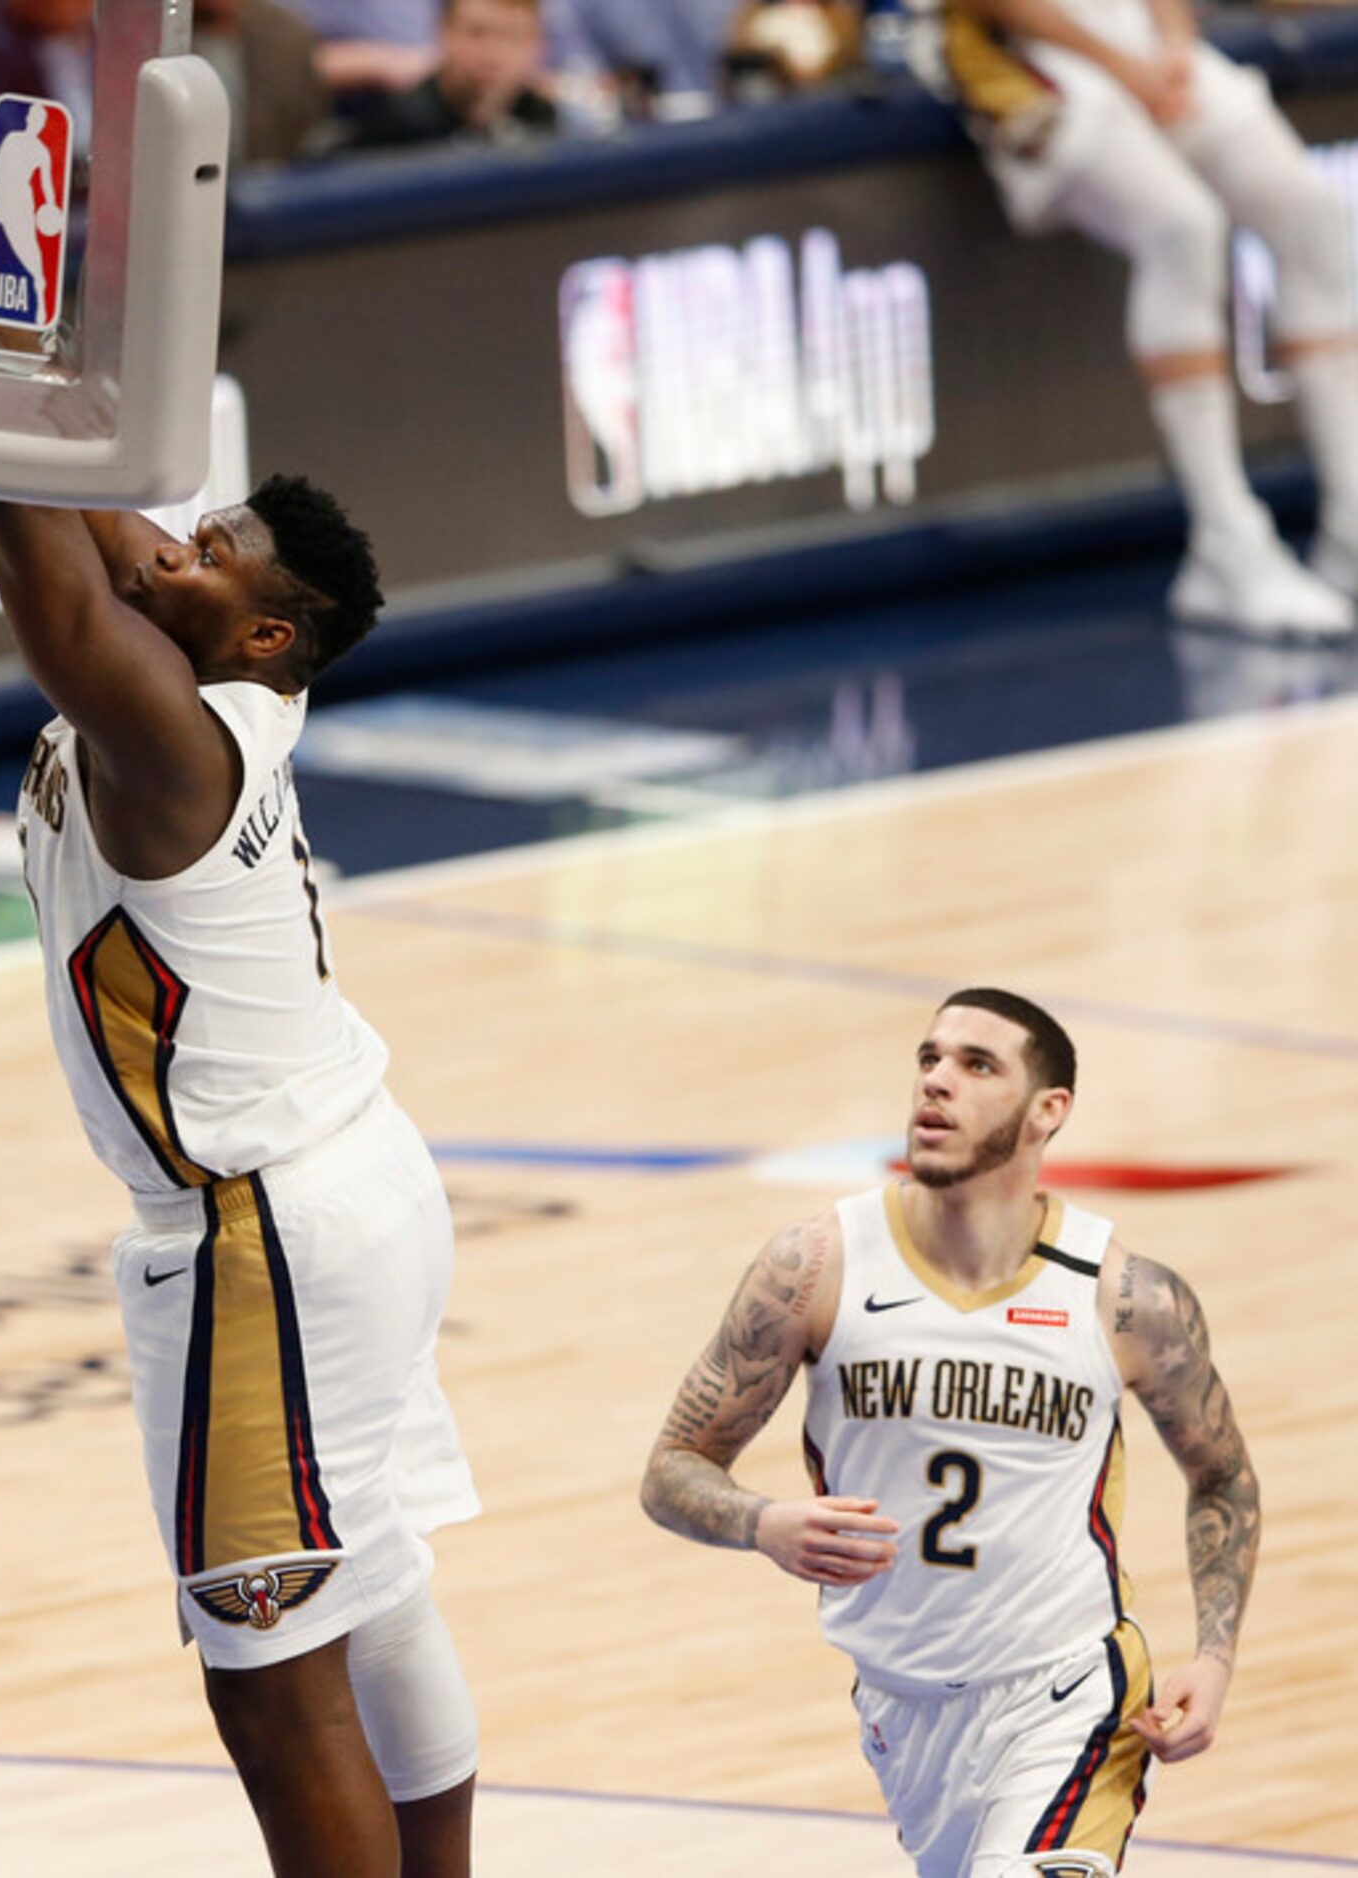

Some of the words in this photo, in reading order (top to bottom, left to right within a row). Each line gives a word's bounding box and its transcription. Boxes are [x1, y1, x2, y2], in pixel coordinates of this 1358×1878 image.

[292, 834, 331, 984] 1
[837, 1357, 923, 1421] NEW
[930, 1358, 1095, 1443] ORLEANS
[920, 1449, 983, 1571] 2
